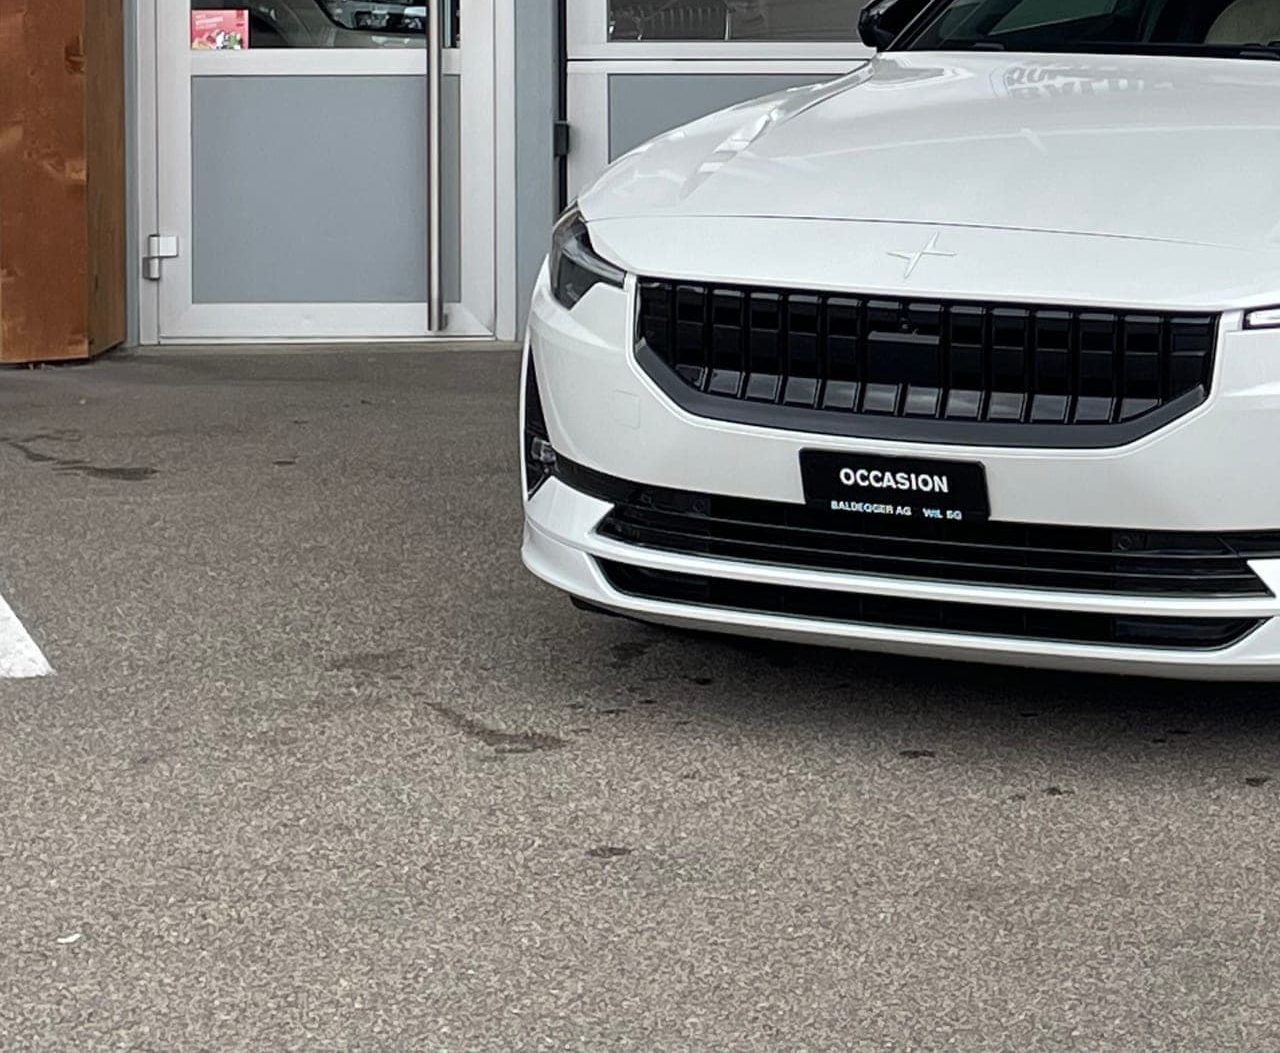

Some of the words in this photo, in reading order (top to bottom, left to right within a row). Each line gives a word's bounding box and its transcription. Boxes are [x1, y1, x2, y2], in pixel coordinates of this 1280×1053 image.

[839, 467, 949, 494] OCCASION
[830, 500, 894, 515] BALDEGGER
[895, 506, 912, 517] AG
